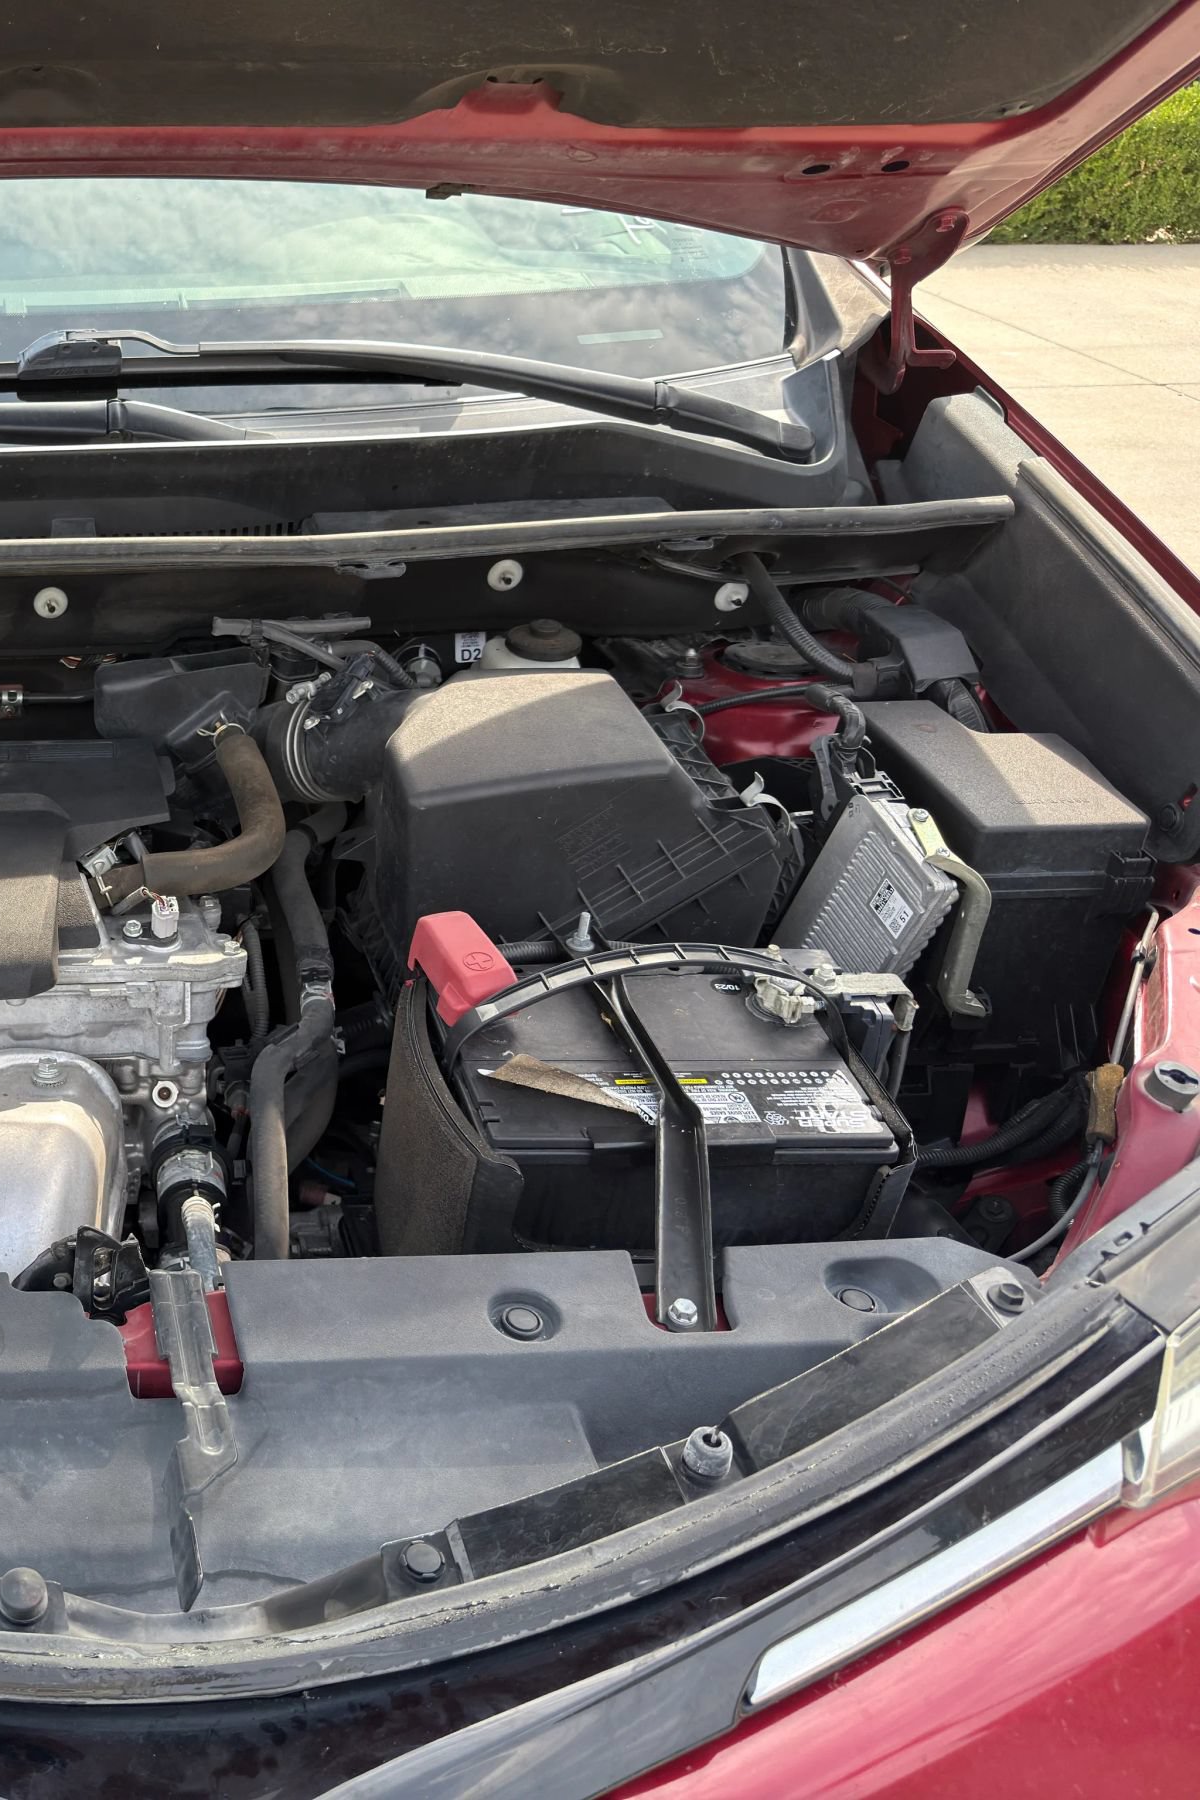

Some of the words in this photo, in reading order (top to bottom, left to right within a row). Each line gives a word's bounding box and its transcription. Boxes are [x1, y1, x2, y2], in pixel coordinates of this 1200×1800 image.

[461, 648, 481, 661] D2
[714, 983, 741, 991] 10/23
[795, 1109, 868, 1120] START
[797, 1119, 866, 1128] SUPER
